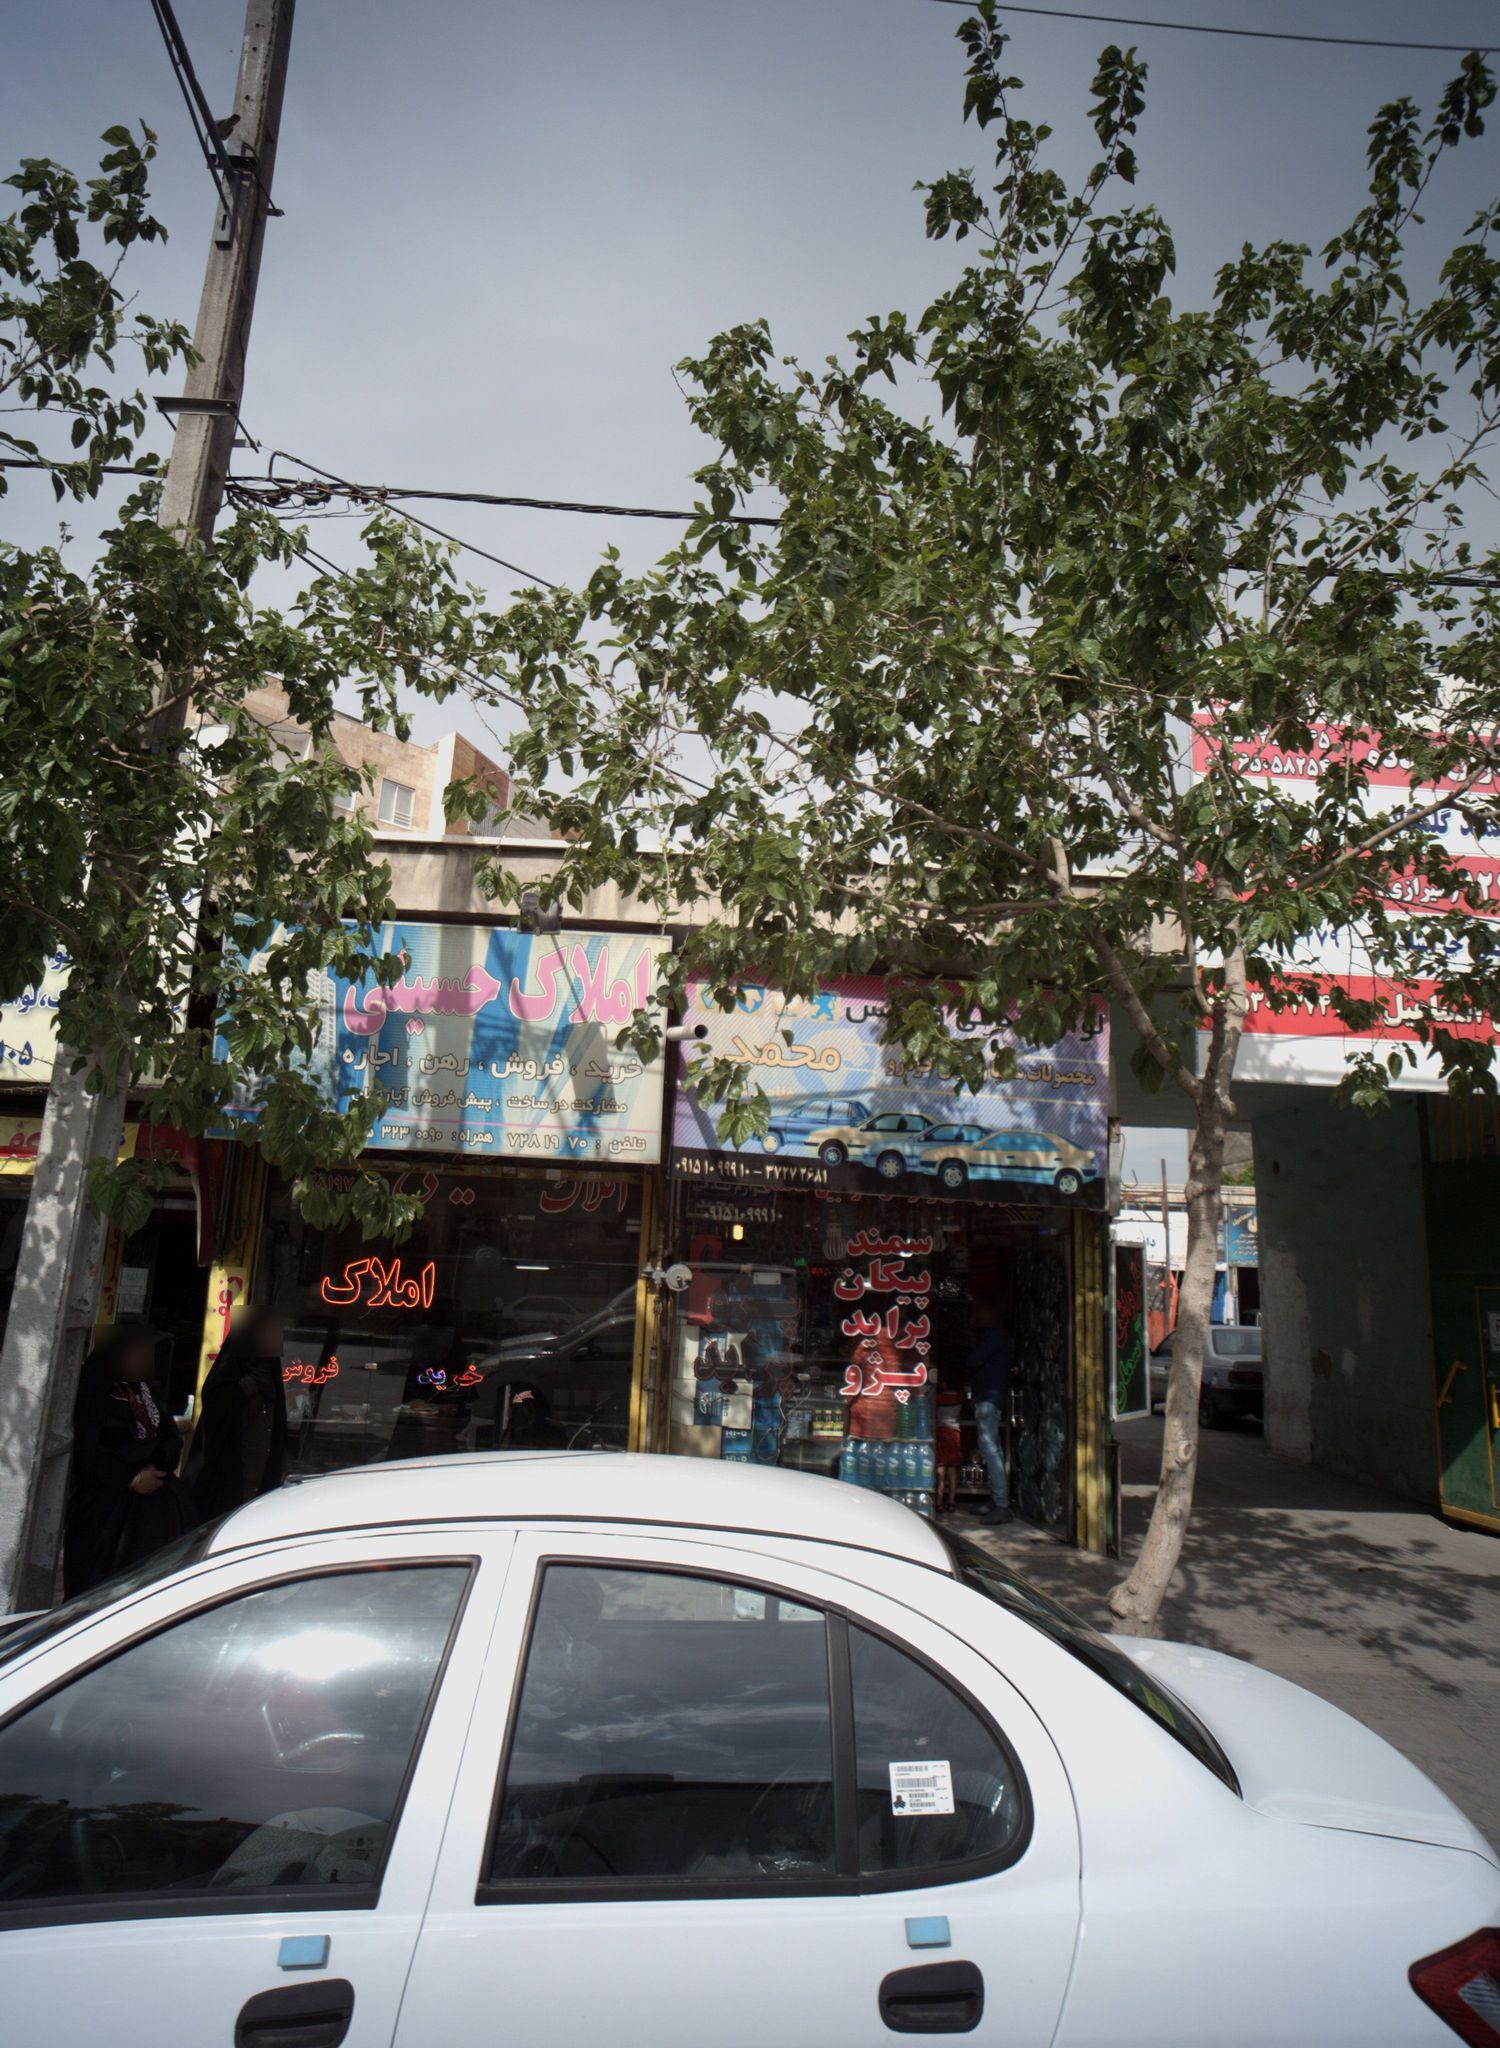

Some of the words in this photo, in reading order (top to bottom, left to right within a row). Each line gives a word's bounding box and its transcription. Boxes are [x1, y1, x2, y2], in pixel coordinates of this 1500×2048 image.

[343, 950, 502, 1036] حسینی
[509, 943, 652, 1025] املاک
[343, 1044, 399, 1071] اجاره
[419, 1053, 471, 1078] رهن
[491, 1051, 565, 1080] فروش
[723, 1035, 842, 1073] محمد
[585, 1057, 643, 1084] خرید
[1026, 1062, 1096, 1089] محصولات
[411, 1088, 456, 1107] فروش
[457, 1090, 493, 1113] پیش
[507, 1095, 549, 1110] ساخت
[550, 1099, 568, 1114] در
[571, 1097, 628, 1114] مشارکت
[847, 1227, 934, 1256] سمند
[322, 1257, 436, 1309] املاک
[833, 1258, 933, 1310] پیکان
[841, 1305, 932, 1356] پراید
[417, 1364, 485, 1392] خرید
[839, 1351, 928, 1405] پژو
